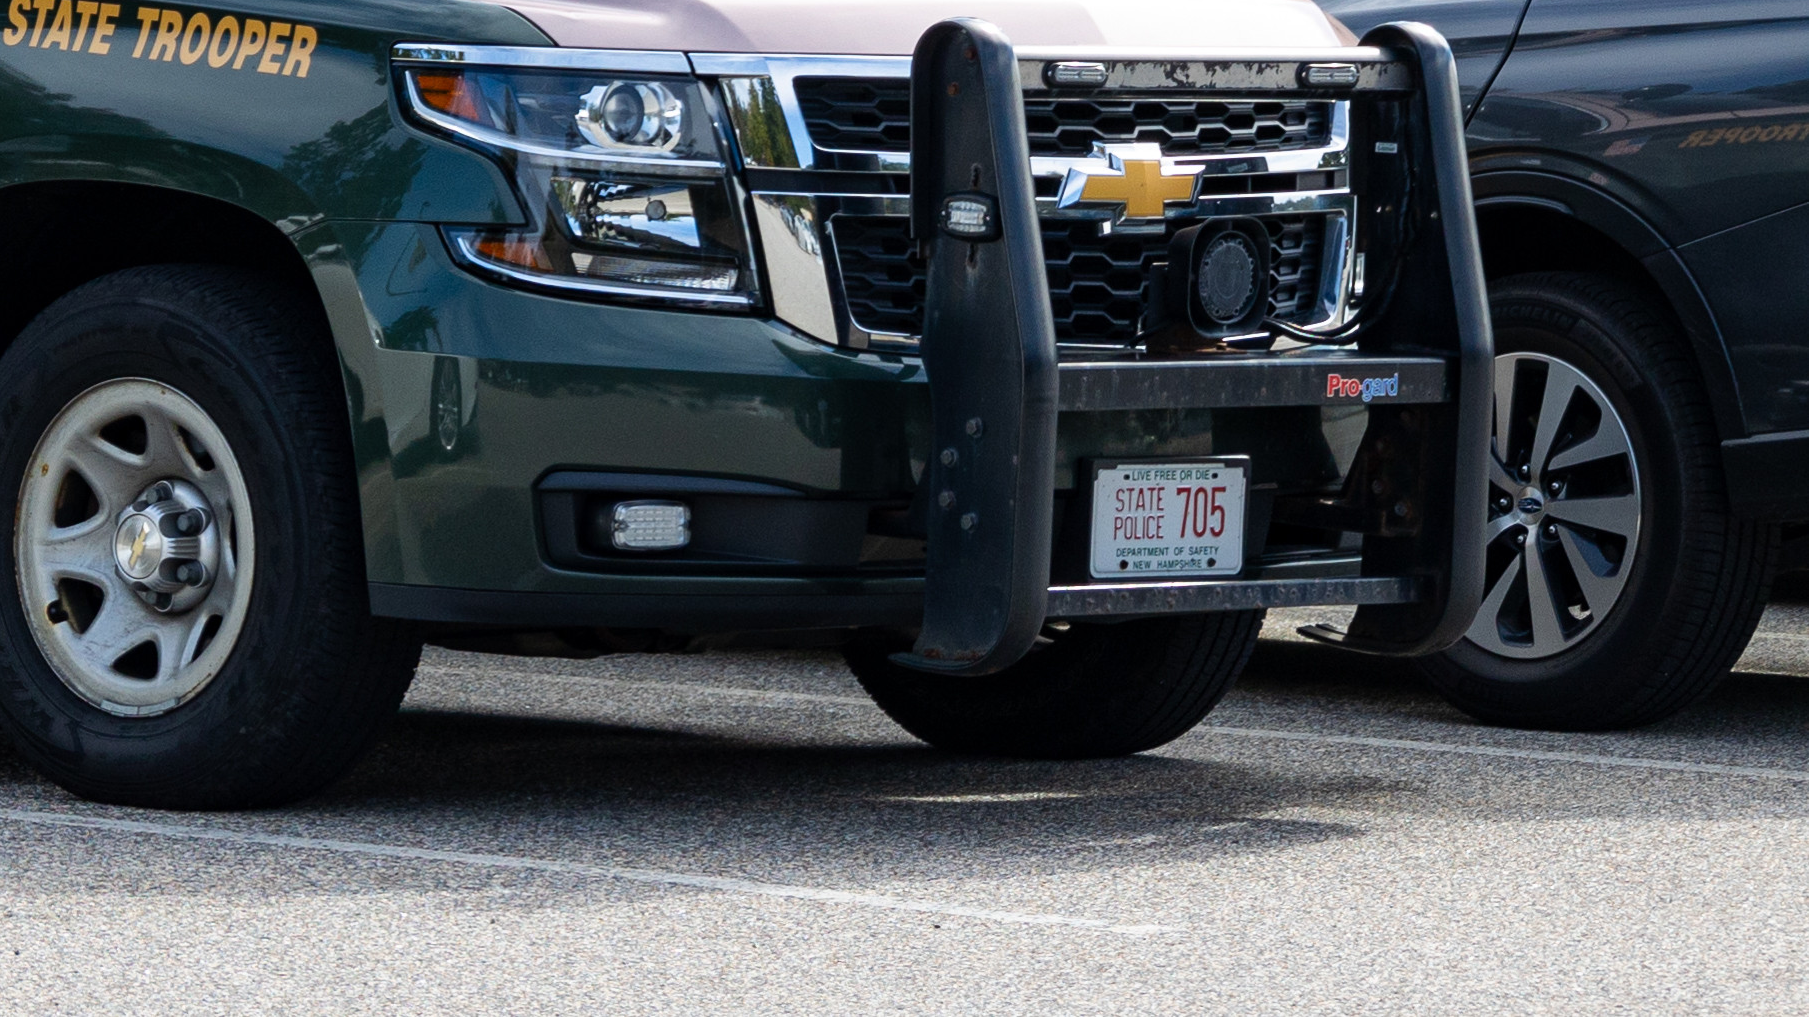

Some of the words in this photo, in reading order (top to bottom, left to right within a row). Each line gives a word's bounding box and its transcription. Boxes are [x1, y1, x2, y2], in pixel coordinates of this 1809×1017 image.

[131, 6, 318, 78] TROOPER
[1131, 470, 1151, 481] LIVE
[1154, 470, 1177, 481] FREE
[1179, 469, 1193, 481] OR
[1195, 469, 1210, 480] DIE
[1115, 486, 1165, 512] STATE
[1176, 486, 1227, 538] 705
[1113, 515, 1165, 541] POLICE
[1115, 546, 1170, 558] DEPARTMENT
[1173, 546, 1184, 556] OF
[1188, 545, 1219, 556] SAFETY
[1132, 560, 1151, 569] NEW
[1157, 559, 1203, 569] HAMPSHIRE
